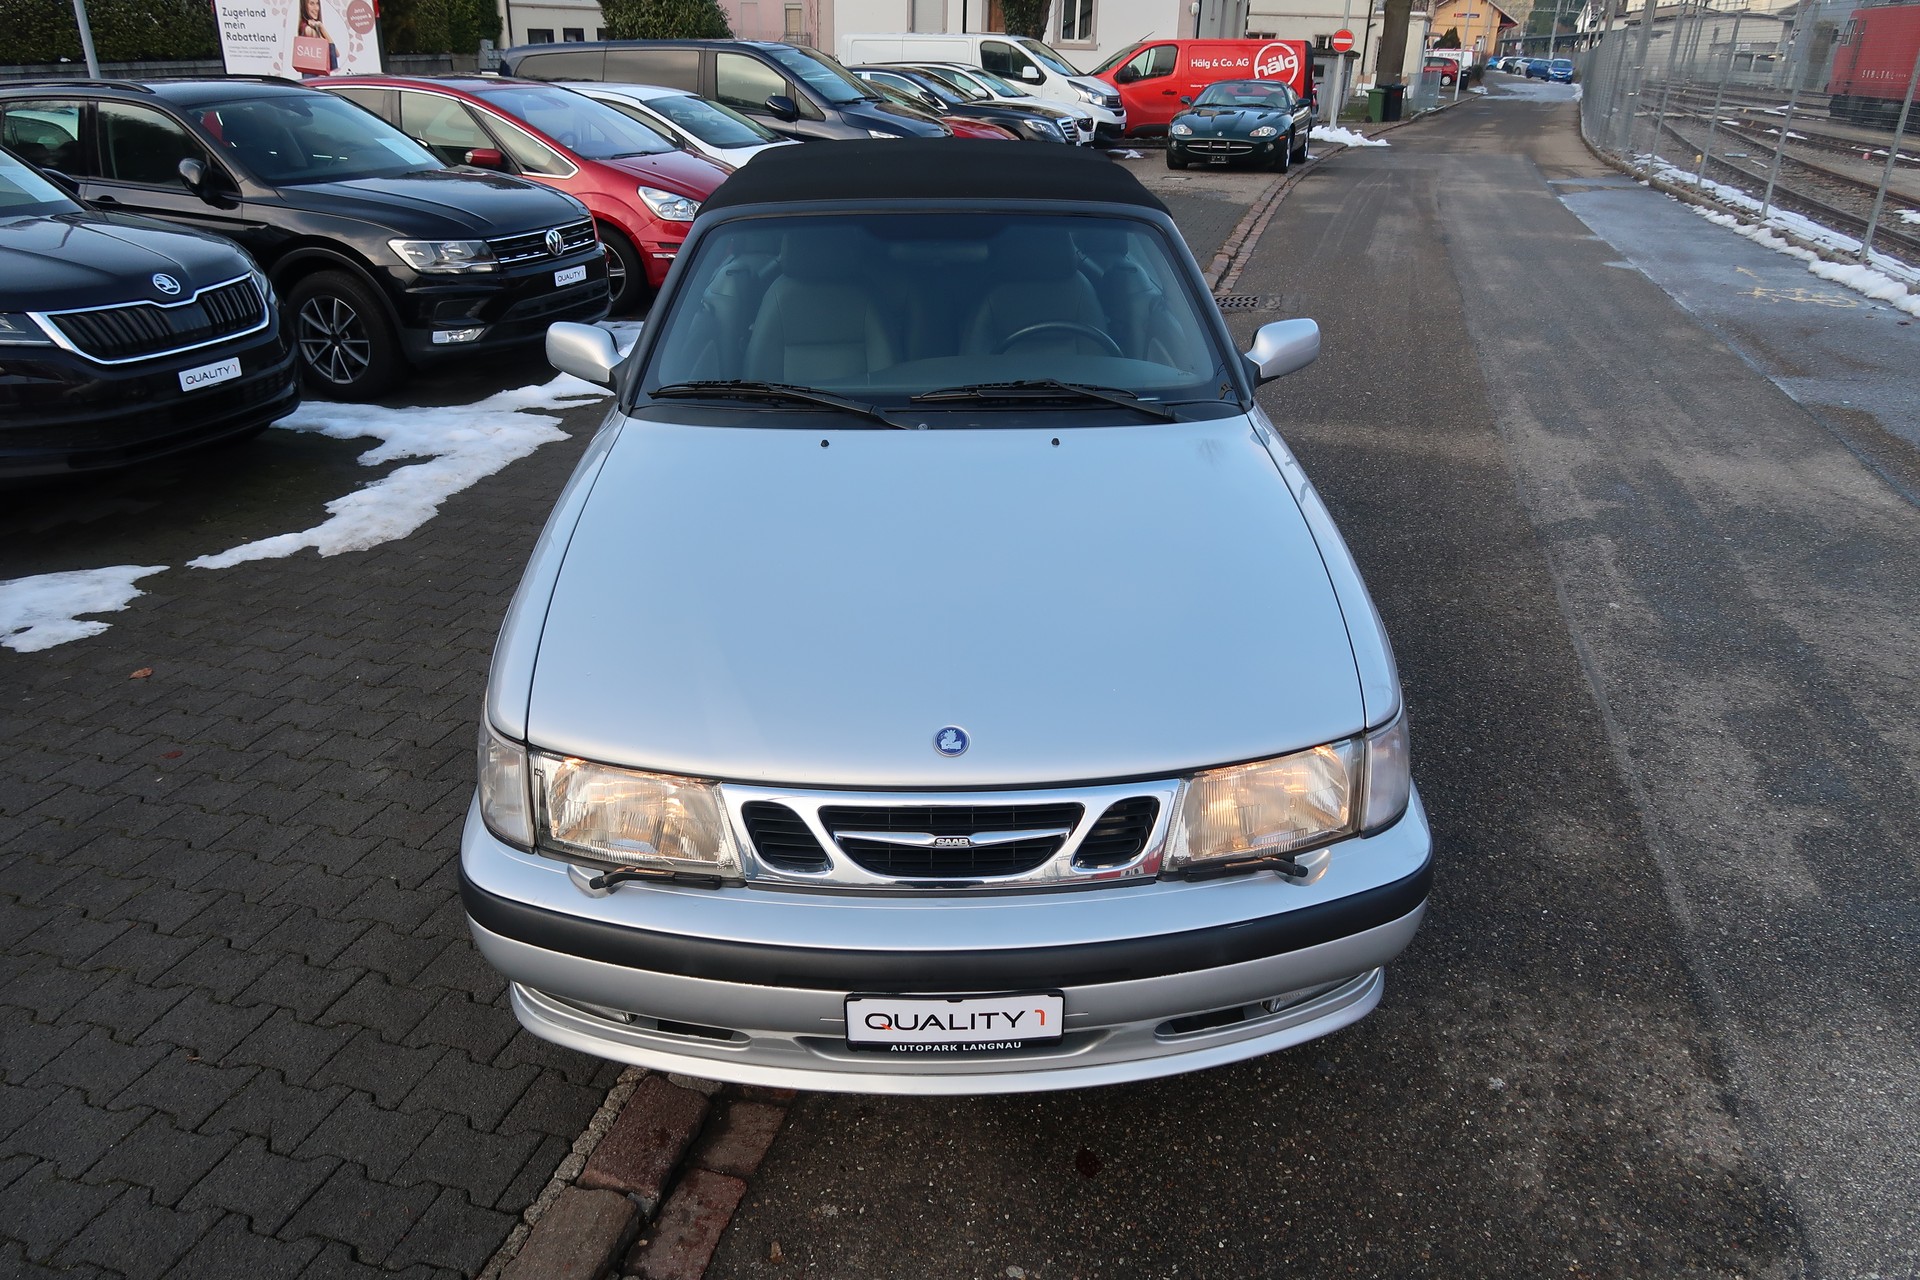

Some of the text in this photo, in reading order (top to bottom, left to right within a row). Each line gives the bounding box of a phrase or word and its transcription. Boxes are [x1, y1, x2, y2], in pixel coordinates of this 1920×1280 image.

[222, 8, 266, 19] Zugerland
[224, 21, 246, 30] mein
[226, 32, 276, 42] Rabattland
[297, 45, 322, 58] SALE
[1191, 58, 1250, 69] Hälg & Co. AG
[558, 270, 581, 282] QUALITY
[185, 365, 231, 385] QUALITY
[232, 364, 237, 372] 1
[936, 838, 969, 847] SAAB
[864, 1009, 1046, 1031] QUALITY 1
[891, 1041, 1022, 1052] AUTOPARK LANGNAU
